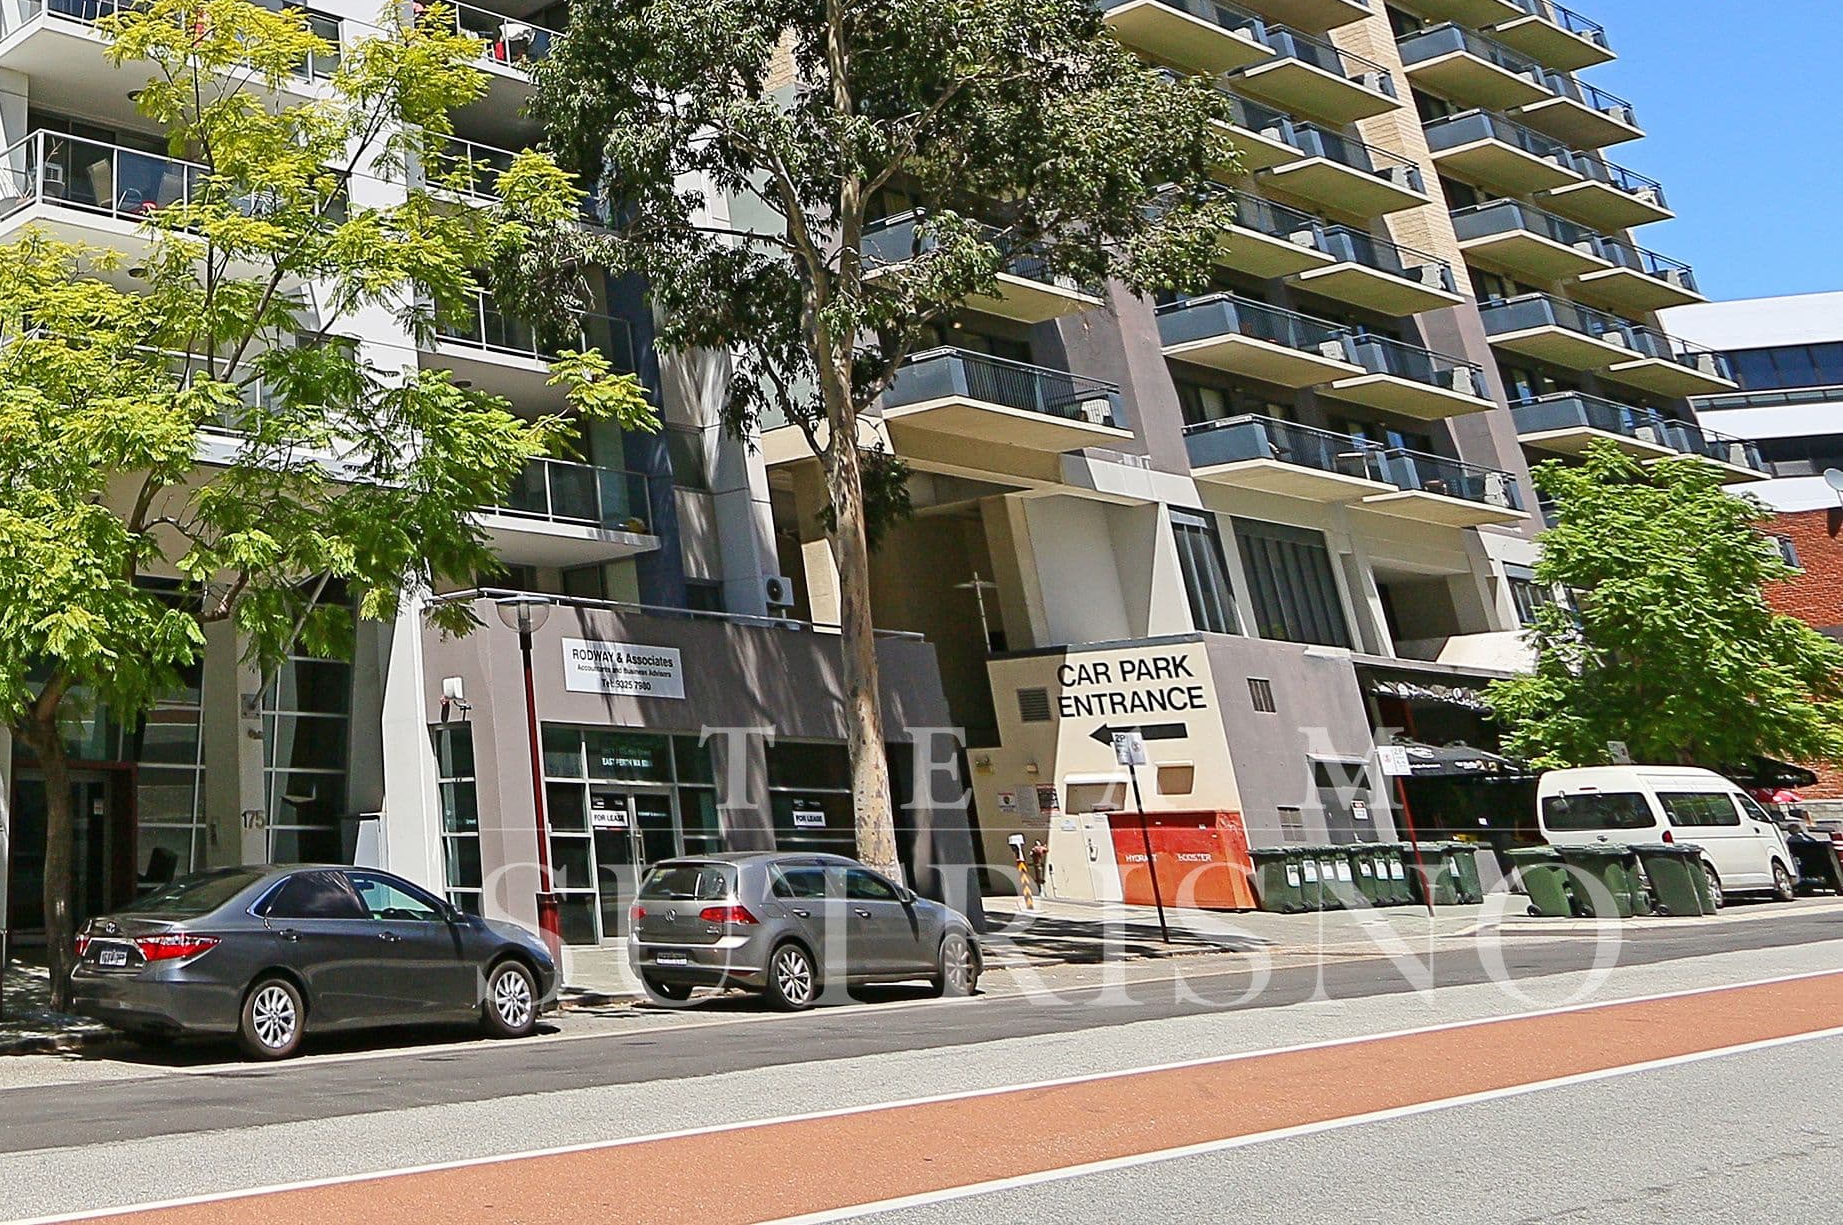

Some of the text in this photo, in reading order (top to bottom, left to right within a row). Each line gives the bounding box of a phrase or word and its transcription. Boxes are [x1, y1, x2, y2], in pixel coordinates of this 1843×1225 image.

[572, 649, 674, 668] RODWAY & Associates
[1057, 655, 1195, 687] CAR PARK
[1057, 686, 1207, 718] ENTRANCE
[241, 810, 265, 829] 175
[594, 814, 625, 823] FOR LEASE
[807, 815, 823, 823] LEASE
[1125, 854, 1157, 863] HYDRAT
[1177, 853, 1212, 862] BOOSTER
